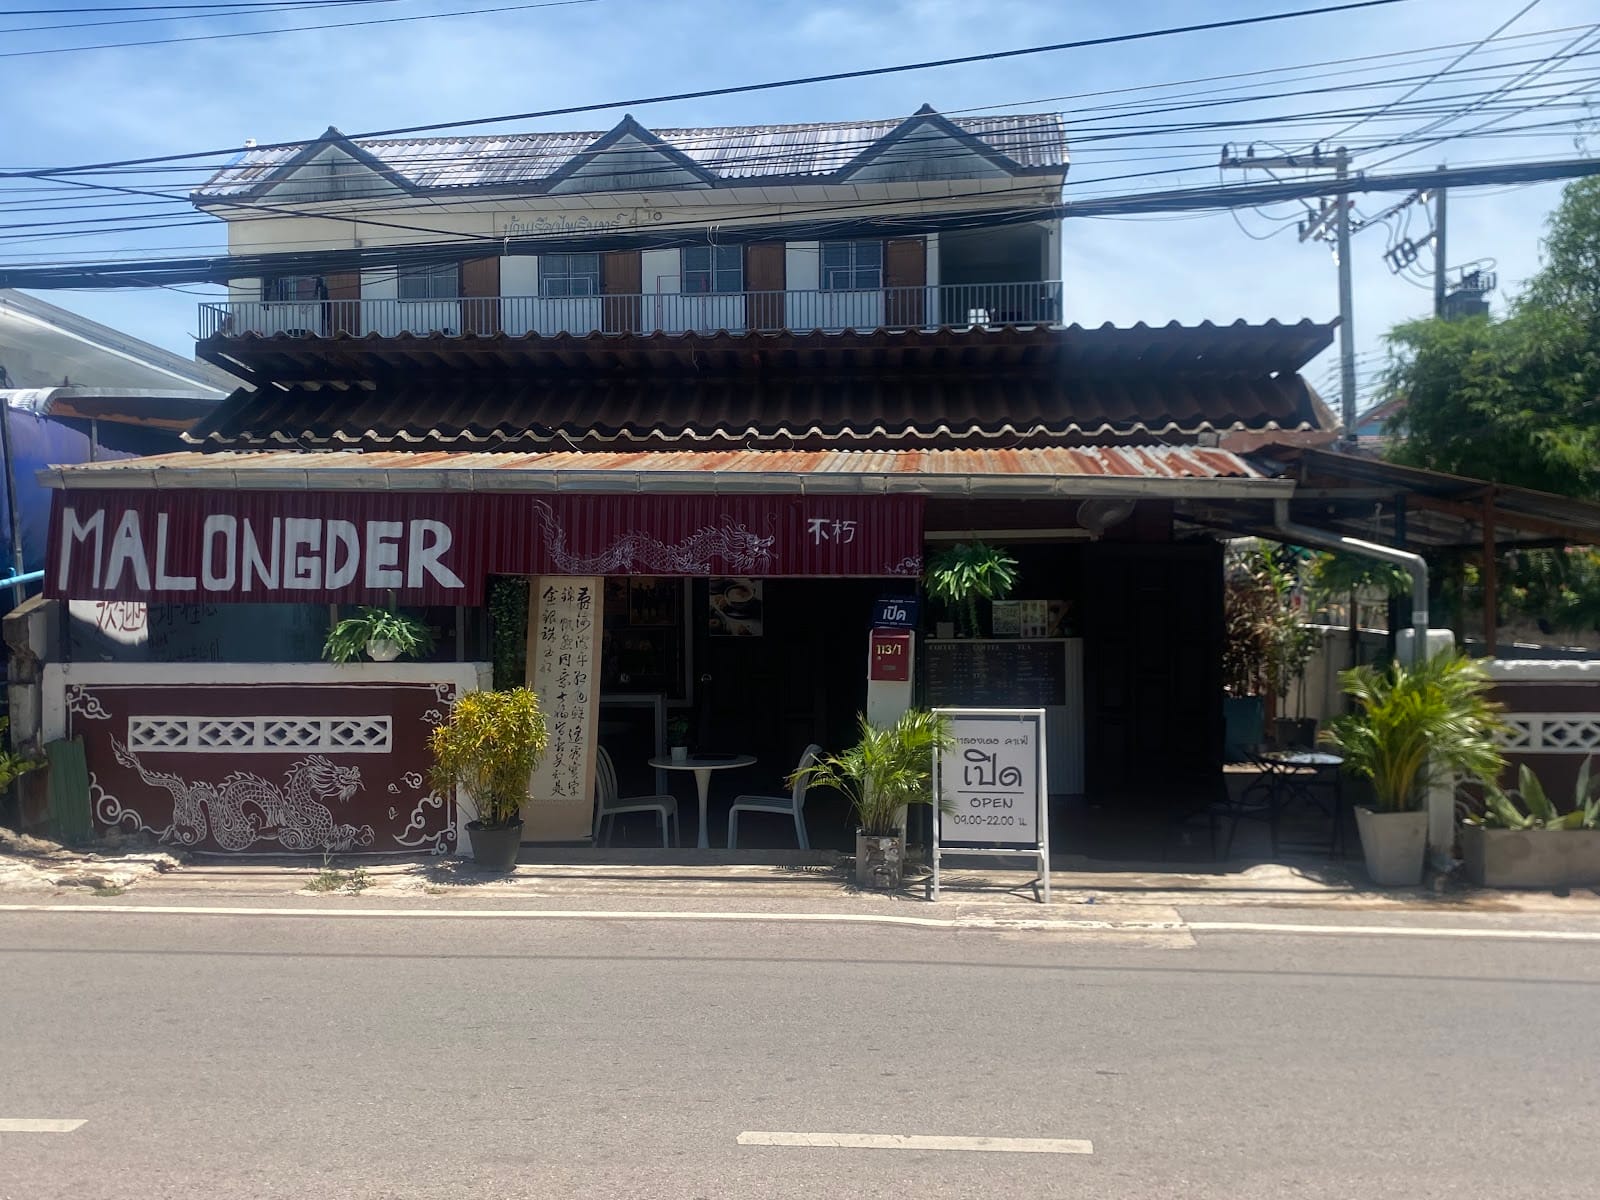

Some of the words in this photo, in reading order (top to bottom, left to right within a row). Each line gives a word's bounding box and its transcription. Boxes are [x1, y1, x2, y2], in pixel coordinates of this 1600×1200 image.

[807, 518, 857, 545] 不朽
[58, 507, 465, 592] MALONGDER
[882, 605, 907, 621] เปิด
[876, 644, 902, 656] 113/1
[963, 748, 1022, 787] เปิด
[969, 797, 1014, 809] OPEN
[953, 814, 1014, 826] 09.00-22.00
